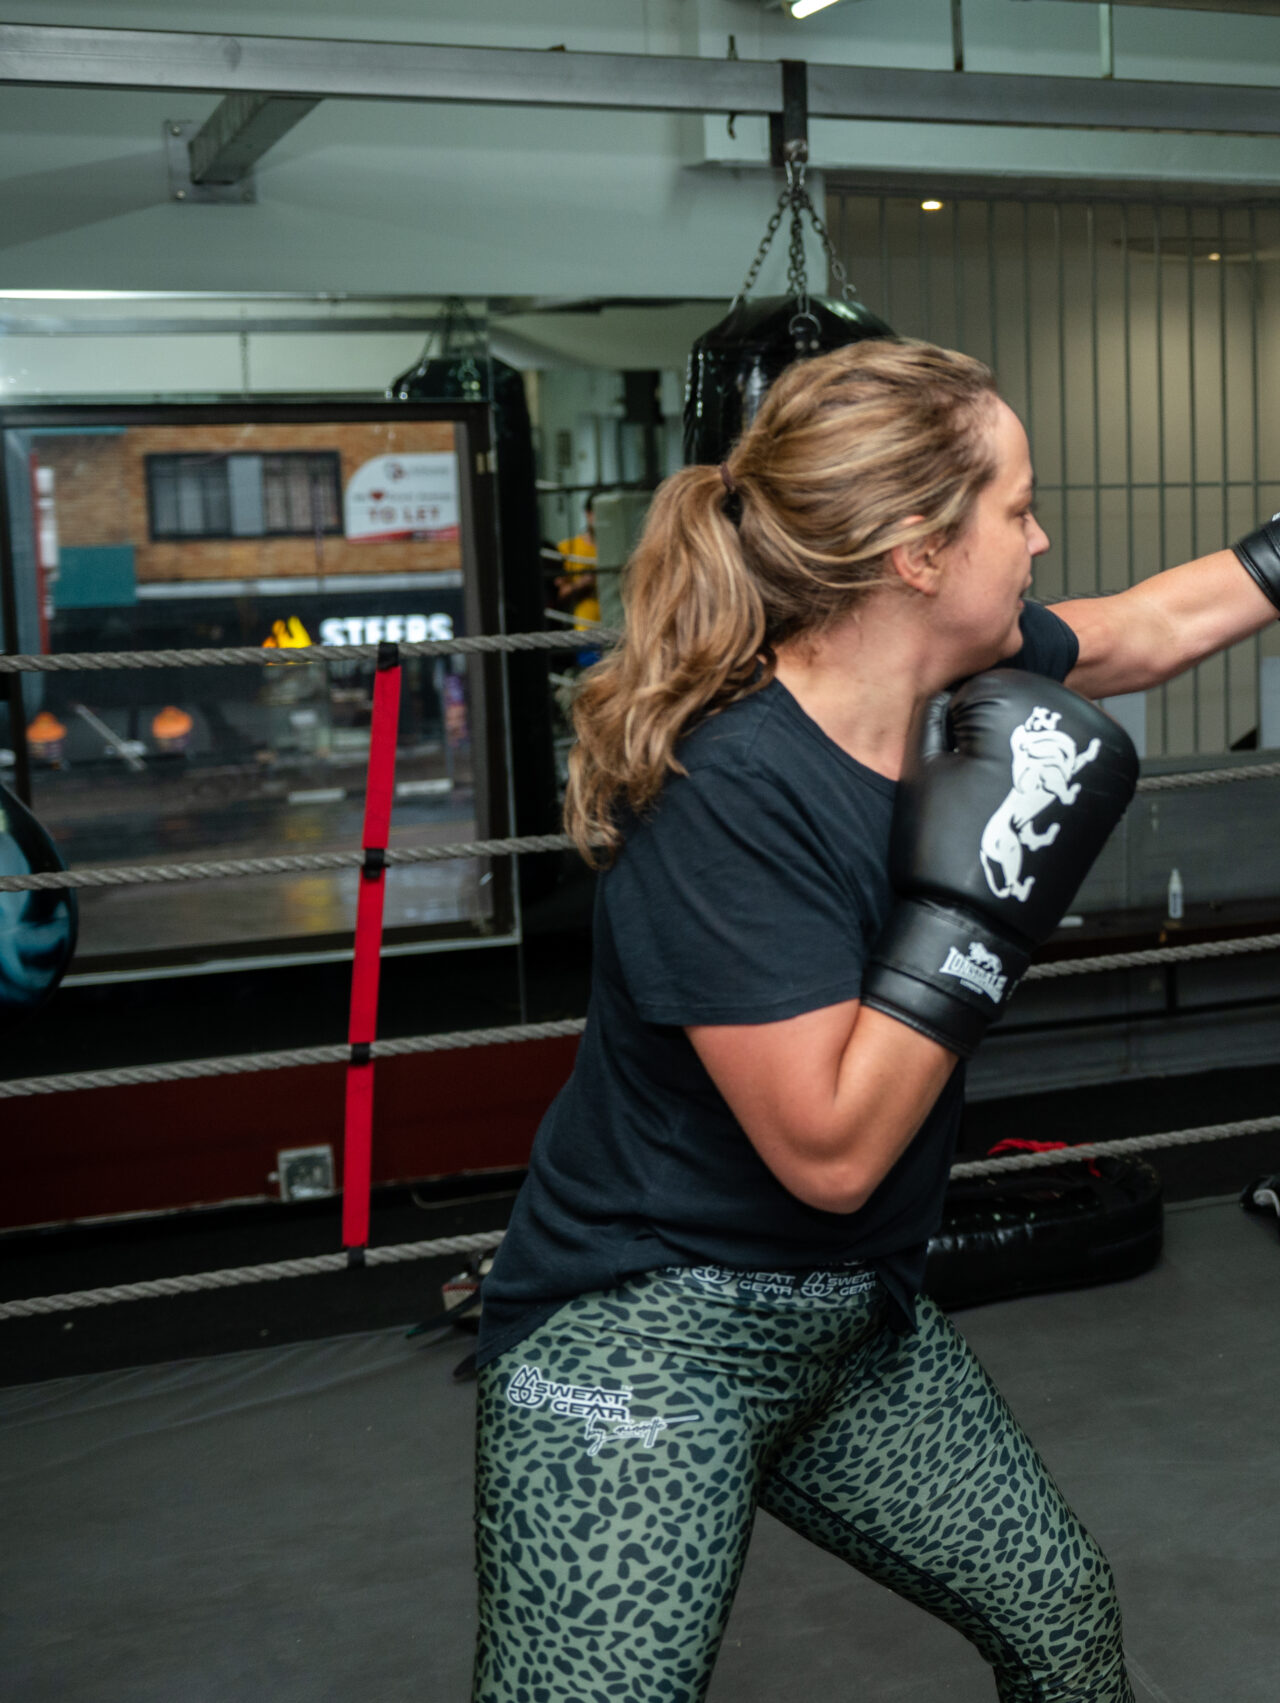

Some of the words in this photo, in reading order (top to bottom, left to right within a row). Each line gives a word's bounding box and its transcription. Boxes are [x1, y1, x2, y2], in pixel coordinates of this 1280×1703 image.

[368, 505, 397, 524] TO
[402, 503, 440, 523] LET
[739, 1280, 793, 1296] GEAR
[534, 1380, 631, 1405] SWEAT
[551, 1400, 629, 1421] GEAR
